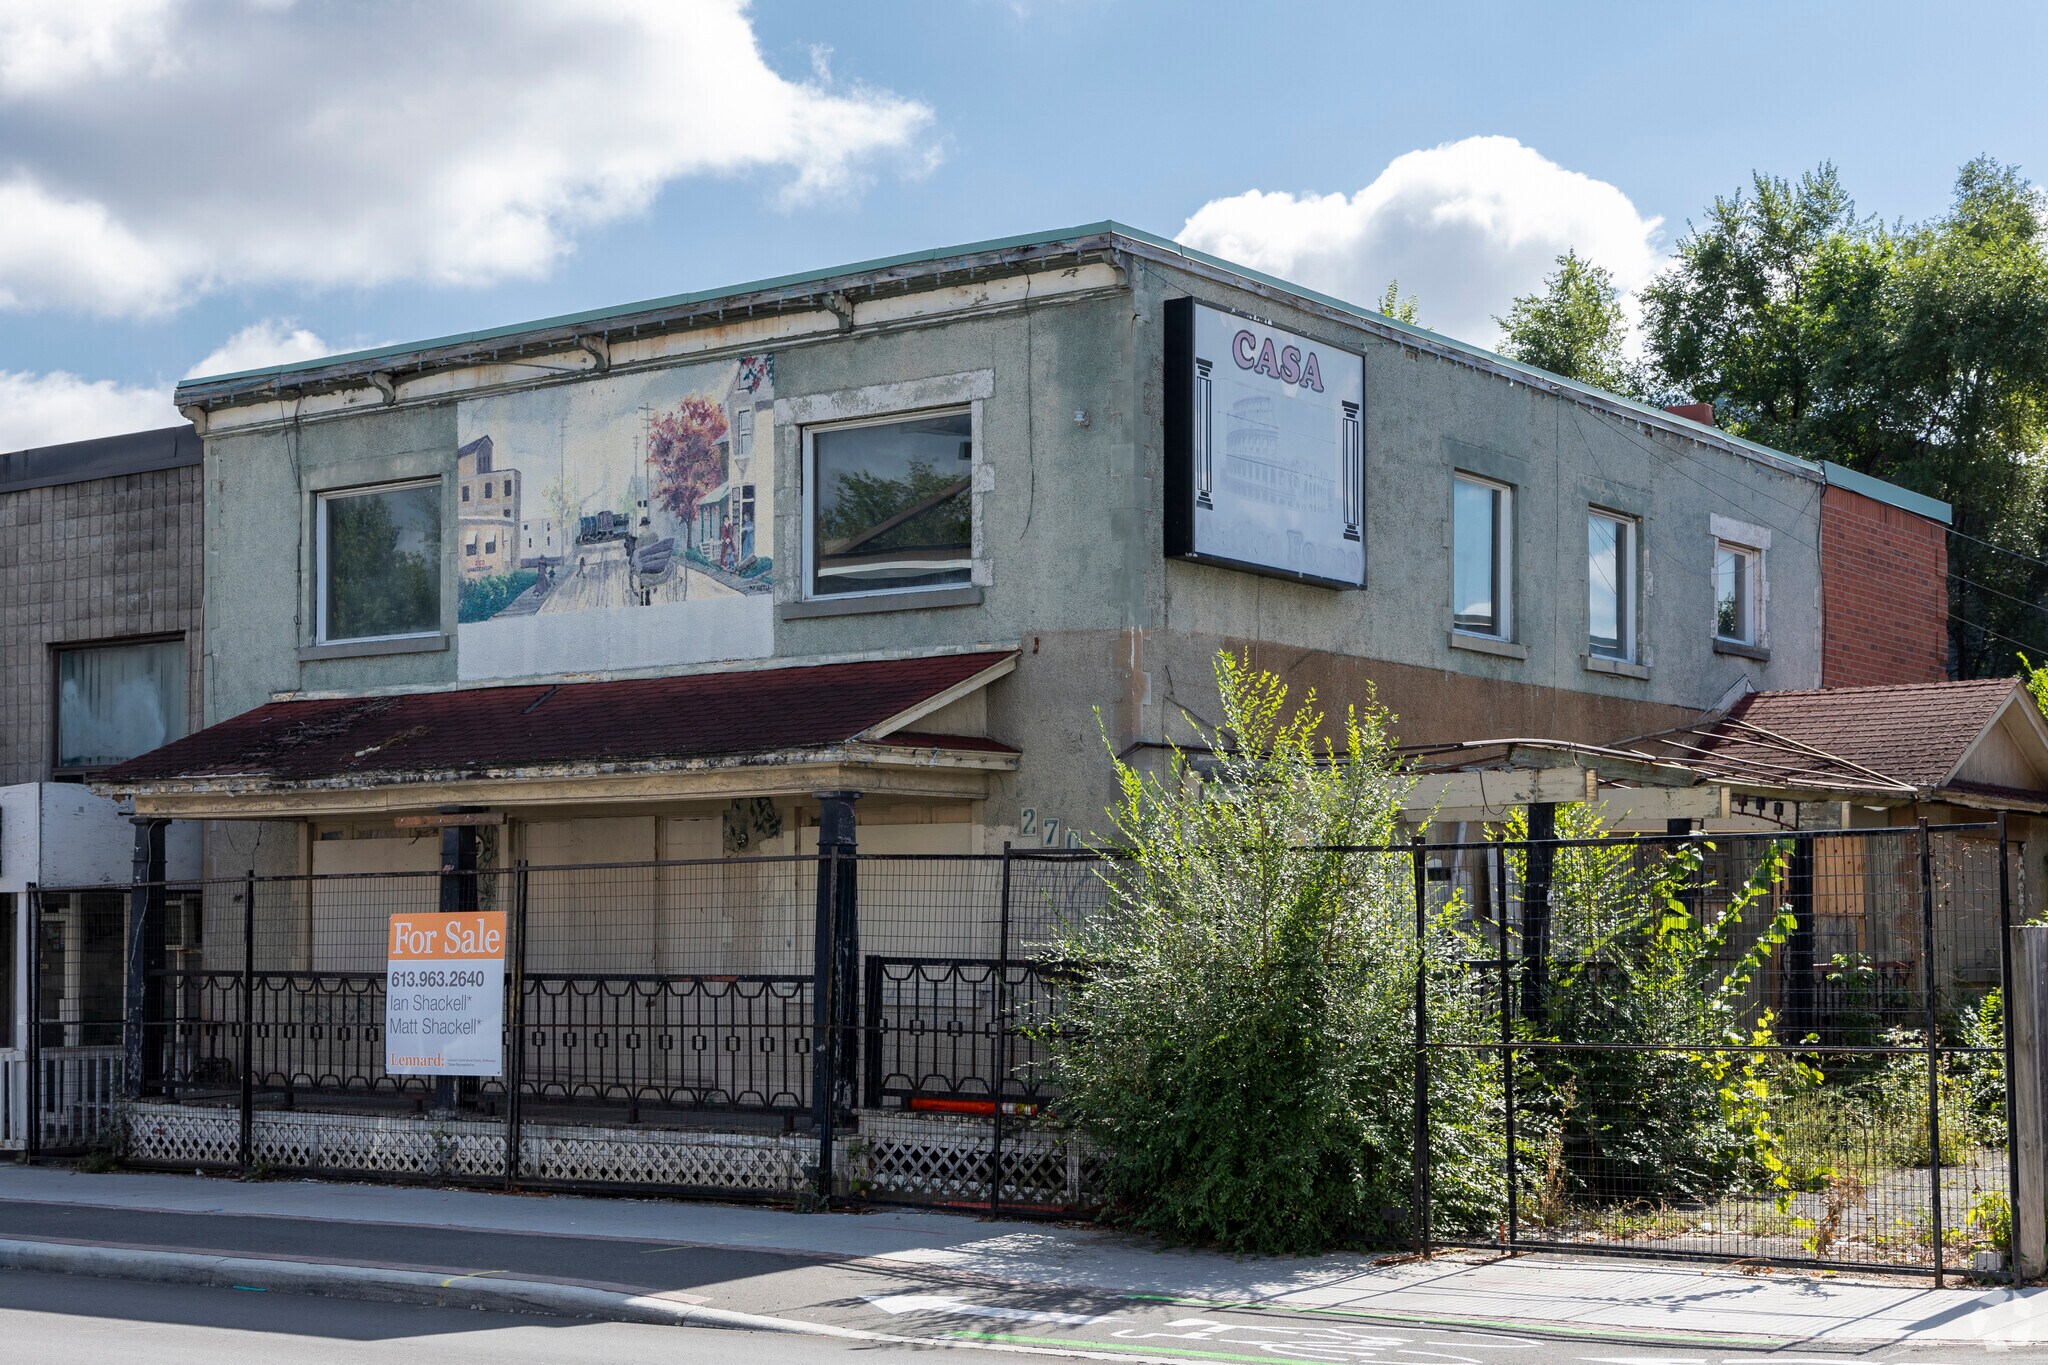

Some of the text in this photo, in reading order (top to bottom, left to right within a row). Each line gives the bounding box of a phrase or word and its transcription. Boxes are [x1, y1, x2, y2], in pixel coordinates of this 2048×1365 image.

[1232, 330, 1324, 392] CASA
[392, 918, 500, 954] For Sale
[391, 970, 485, 987] 613.963.2640
[390, 995, 409, 1011] Ian
[389, 1018, 418, 1034] Matt
